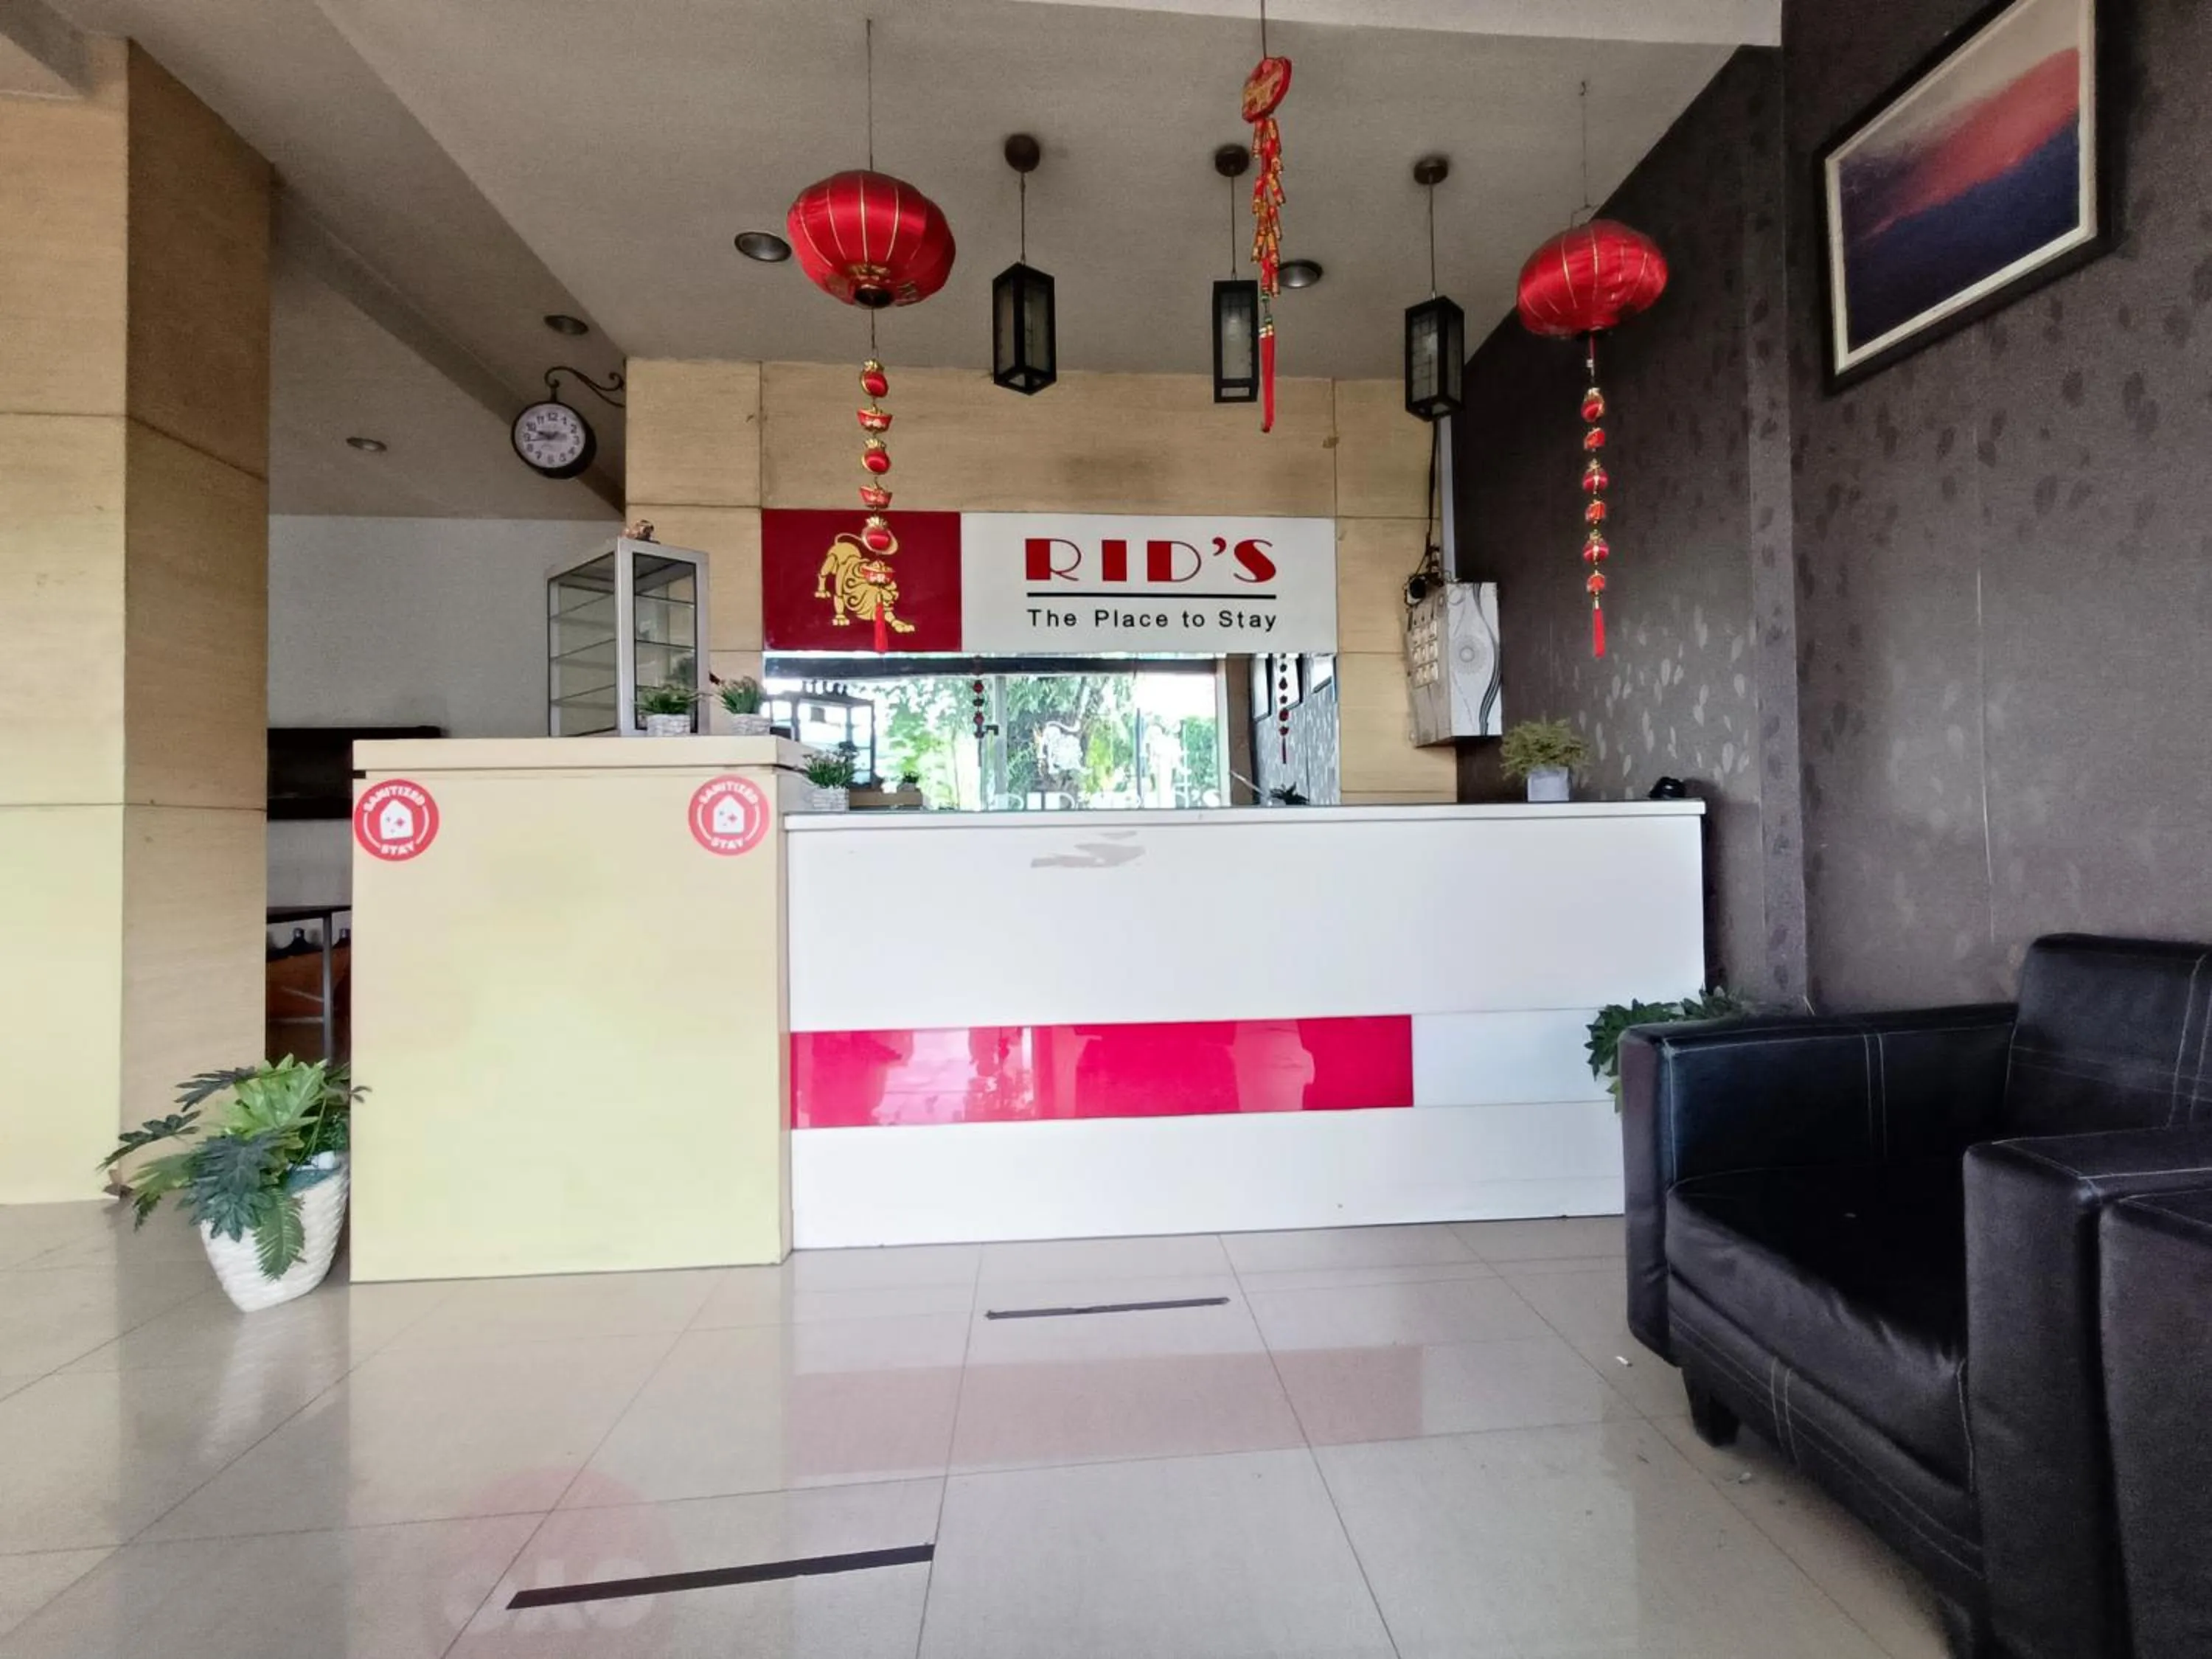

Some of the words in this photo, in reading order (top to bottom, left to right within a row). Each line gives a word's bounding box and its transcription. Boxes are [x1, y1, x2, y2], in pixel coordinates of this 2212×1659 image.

[536, 415, 545, 425] 11
[548, 412, 558, 421] 12
[570, 423, 577, 434] 2
[535, 450, 543, 460] 7
[1025, 536, 1277, 583] RID'S
[1027, 608, 1077, 627] The
[1094, 609, 1169, 628] Place
[1182, 610, 1206, 628] to
[1219, 609, 1277, 632] Stay
[363, 785, 425, 813] SANITIZED
[698, 780, 759, 804] SANITIZED
[380, 841, 414, 856] STAY
[710, 837, 744, 850] STAY
